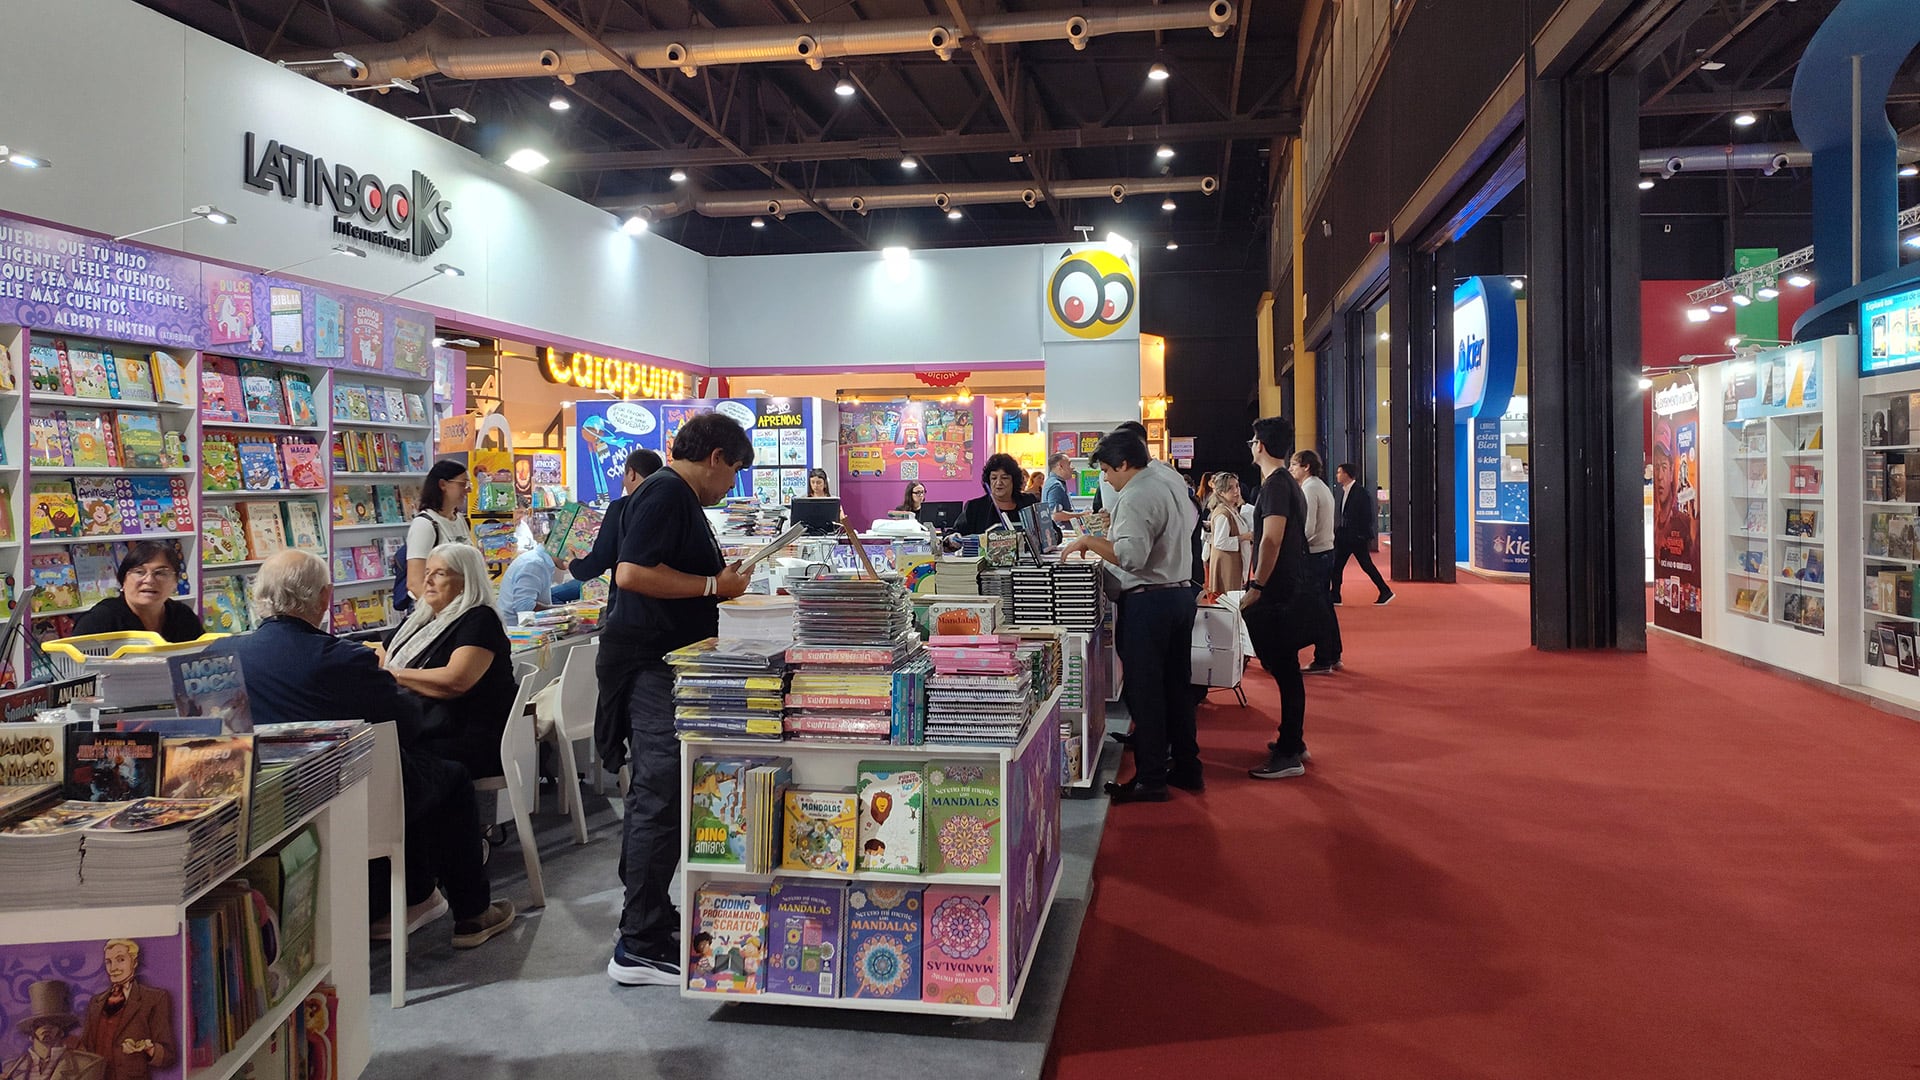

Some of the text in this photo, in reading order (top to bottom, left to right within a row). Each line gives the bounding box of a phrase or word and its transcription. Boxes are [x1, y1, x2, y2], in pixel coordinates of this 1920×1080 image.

[244, 132, 452, 256] LATINBOOKS
[333, 215, 410, 253] International
[57, 238, 86, 257] QUE
[92, 246, 109, 261] TU
[114, 252, 146, 270] HIJO
[72, 258, 110, 279] LÉELE
[116, 269, 175, 291] CUENTOS.
[2, 263, 34, 283] QUE
[73, 275, 100, 294] MÁS
[106, 283, 188, 310] INTELIGENTE,
[220, 279, 250, 293] DULCE
[30, 286, 60, 305] MÁS
[66, 292, 130, 316] CUENTOS.
[271, 293, 300, 306] BIBLIA
[357, 307, 380, 321] GENIOS
[54, 311, 100, 329] ALBERT
[106, 319, 156, 338] EINSTEIN
[1466, 334, 1484, 371] kier
[778, 403, 790, 413] NO
[758, 414, 801, 427] APRENDAS
[79, 487, 116, 498] Animales
[180, 656, 234, 679] MOBY
[184, 671, 240, 694] DICK
[58, 686, 72, 704] ANA
[5, 696, 47, 722] Sandokán
[174, 746, 232, 763] Perseo
[971, 788, 994, 796] mente
[802, 803, 841, 813] MANDALAS
[931, 798, 999, 807] MANDALAS
[696, 827, 727, 841] DINO
[695, 840, 725, 854] amigos
[714, 898, 750, 910] CODING
[778, 903, 831, 915] MANDALAS
[702, 909, 760, 920] PROGRAMANDO
[891, 911, 912, 920] mente
[714, 919, 759, 932] SCRATCH
[851, 920, 917, 932] MANDALAS
[927, 961, 994, 973] MANDALAS
